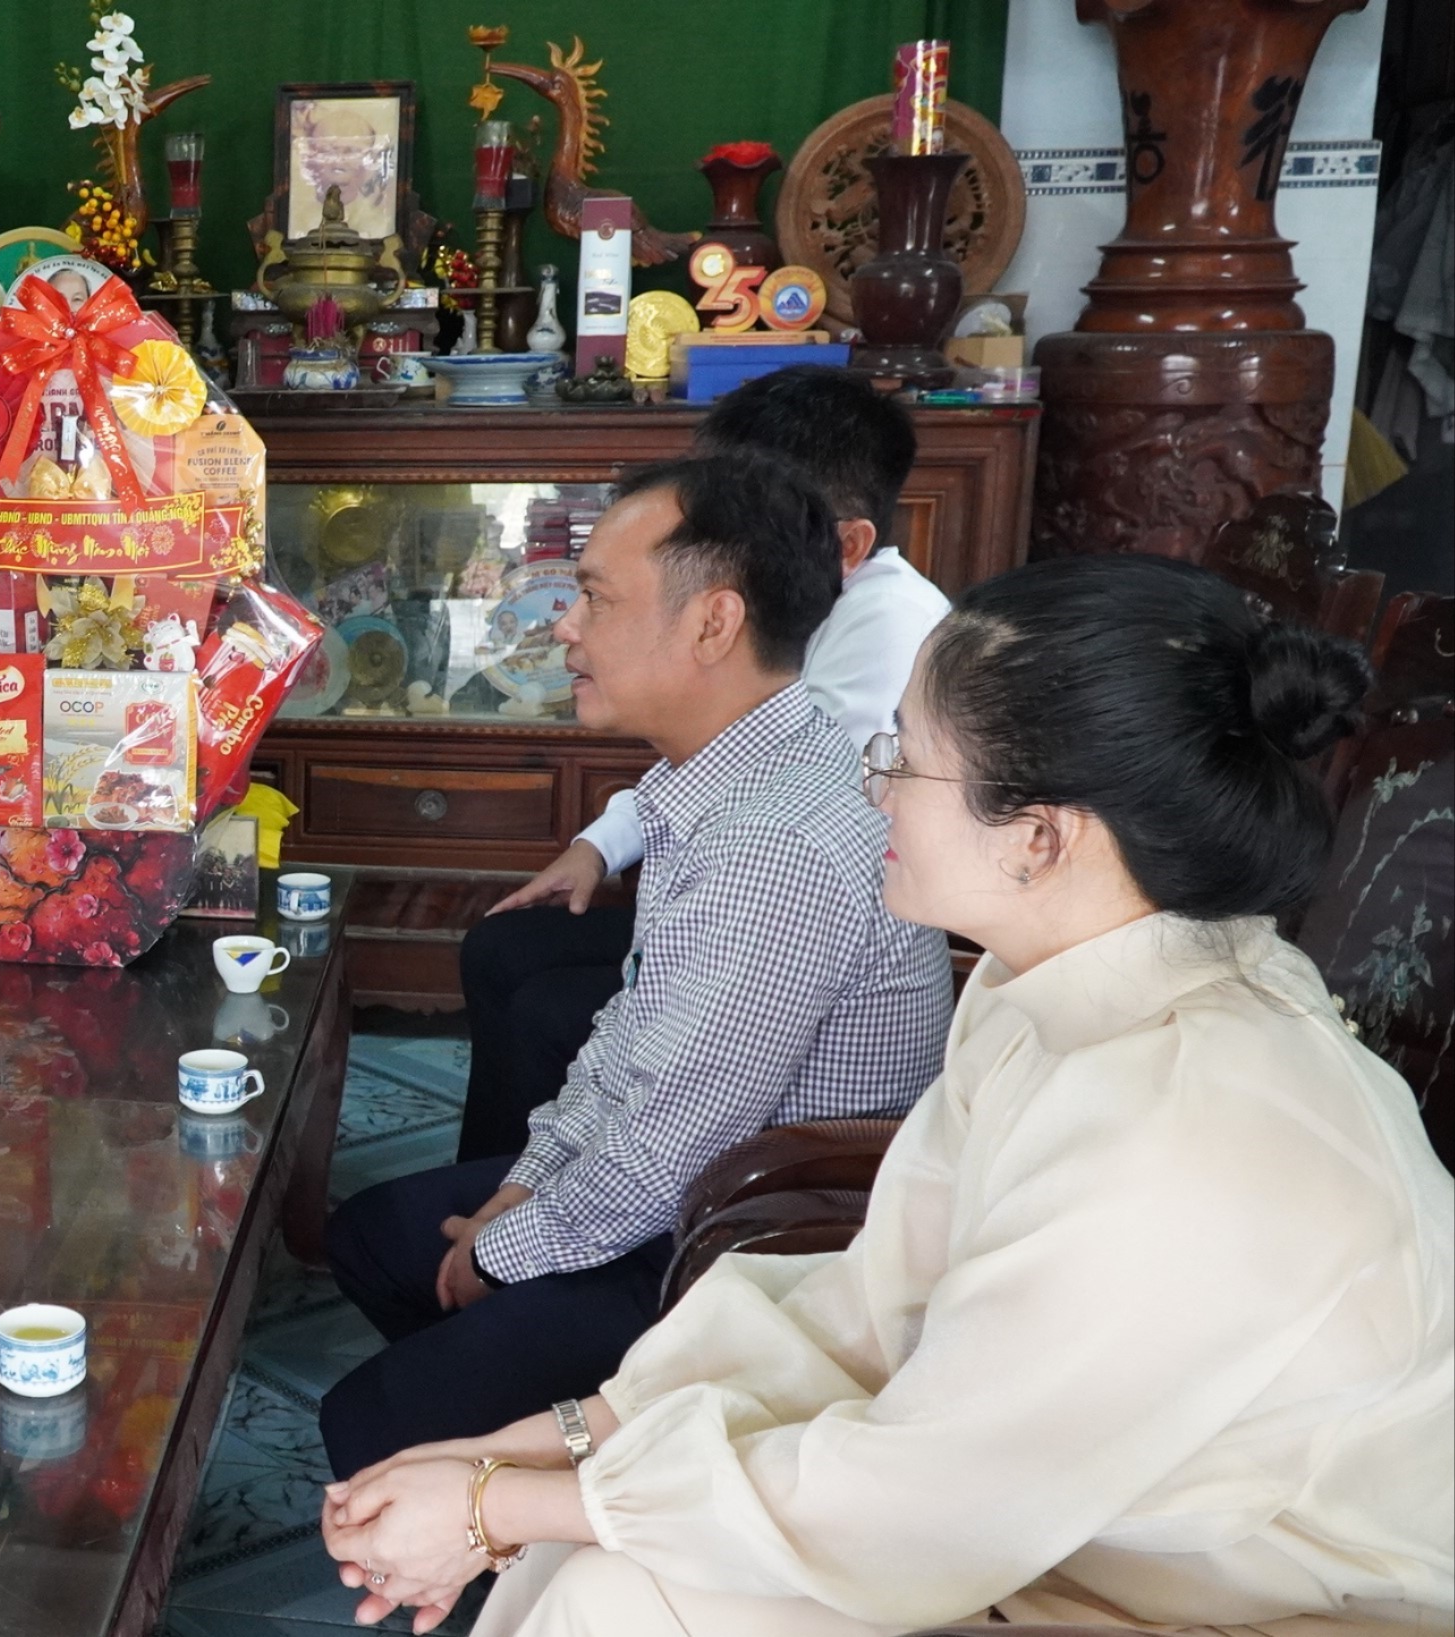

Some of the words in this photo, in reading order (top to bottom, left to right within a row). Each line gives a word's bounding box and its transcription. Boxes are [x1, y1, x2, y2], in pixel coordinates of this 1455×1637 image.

[187, 457, 222, 466] FUSION
[203, 466, 238, 476] COFFEE
[59, 700, 104, 713] OCOP
[216, 701, 241, 731] Pie
[220, 694, 263, 755] Combo
